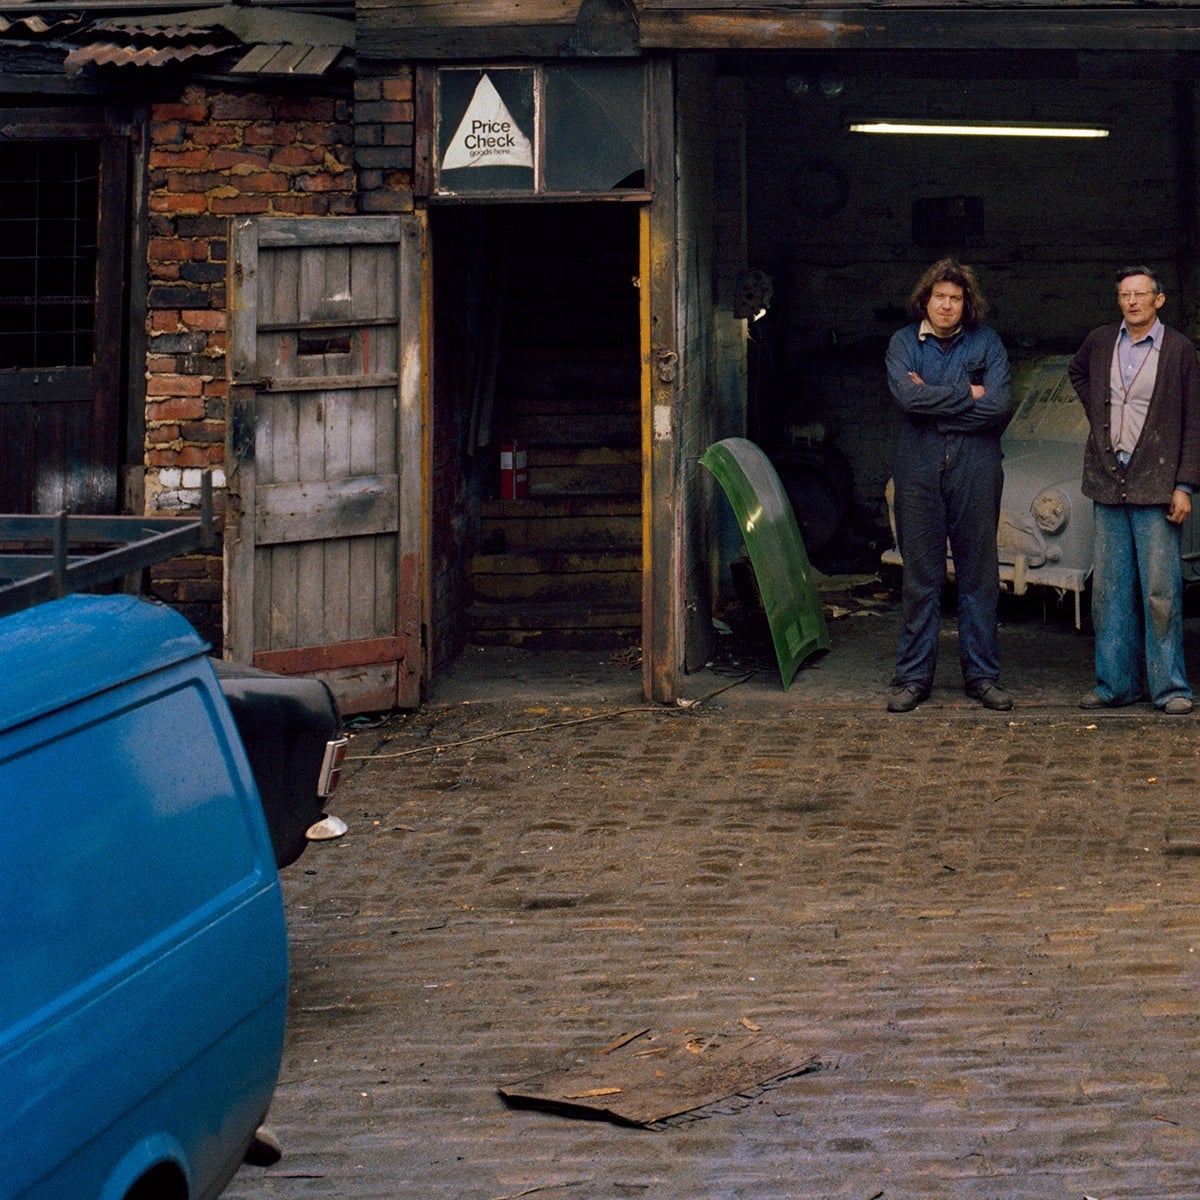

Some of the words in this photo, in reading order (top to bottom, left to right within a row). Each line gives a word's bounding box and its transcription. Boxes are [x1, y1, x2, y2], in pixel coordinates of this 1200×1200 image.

[471, 119, 511, 134] Price
[464, 133, 515, 150] Check
[469, 149, 493, 157] goods
